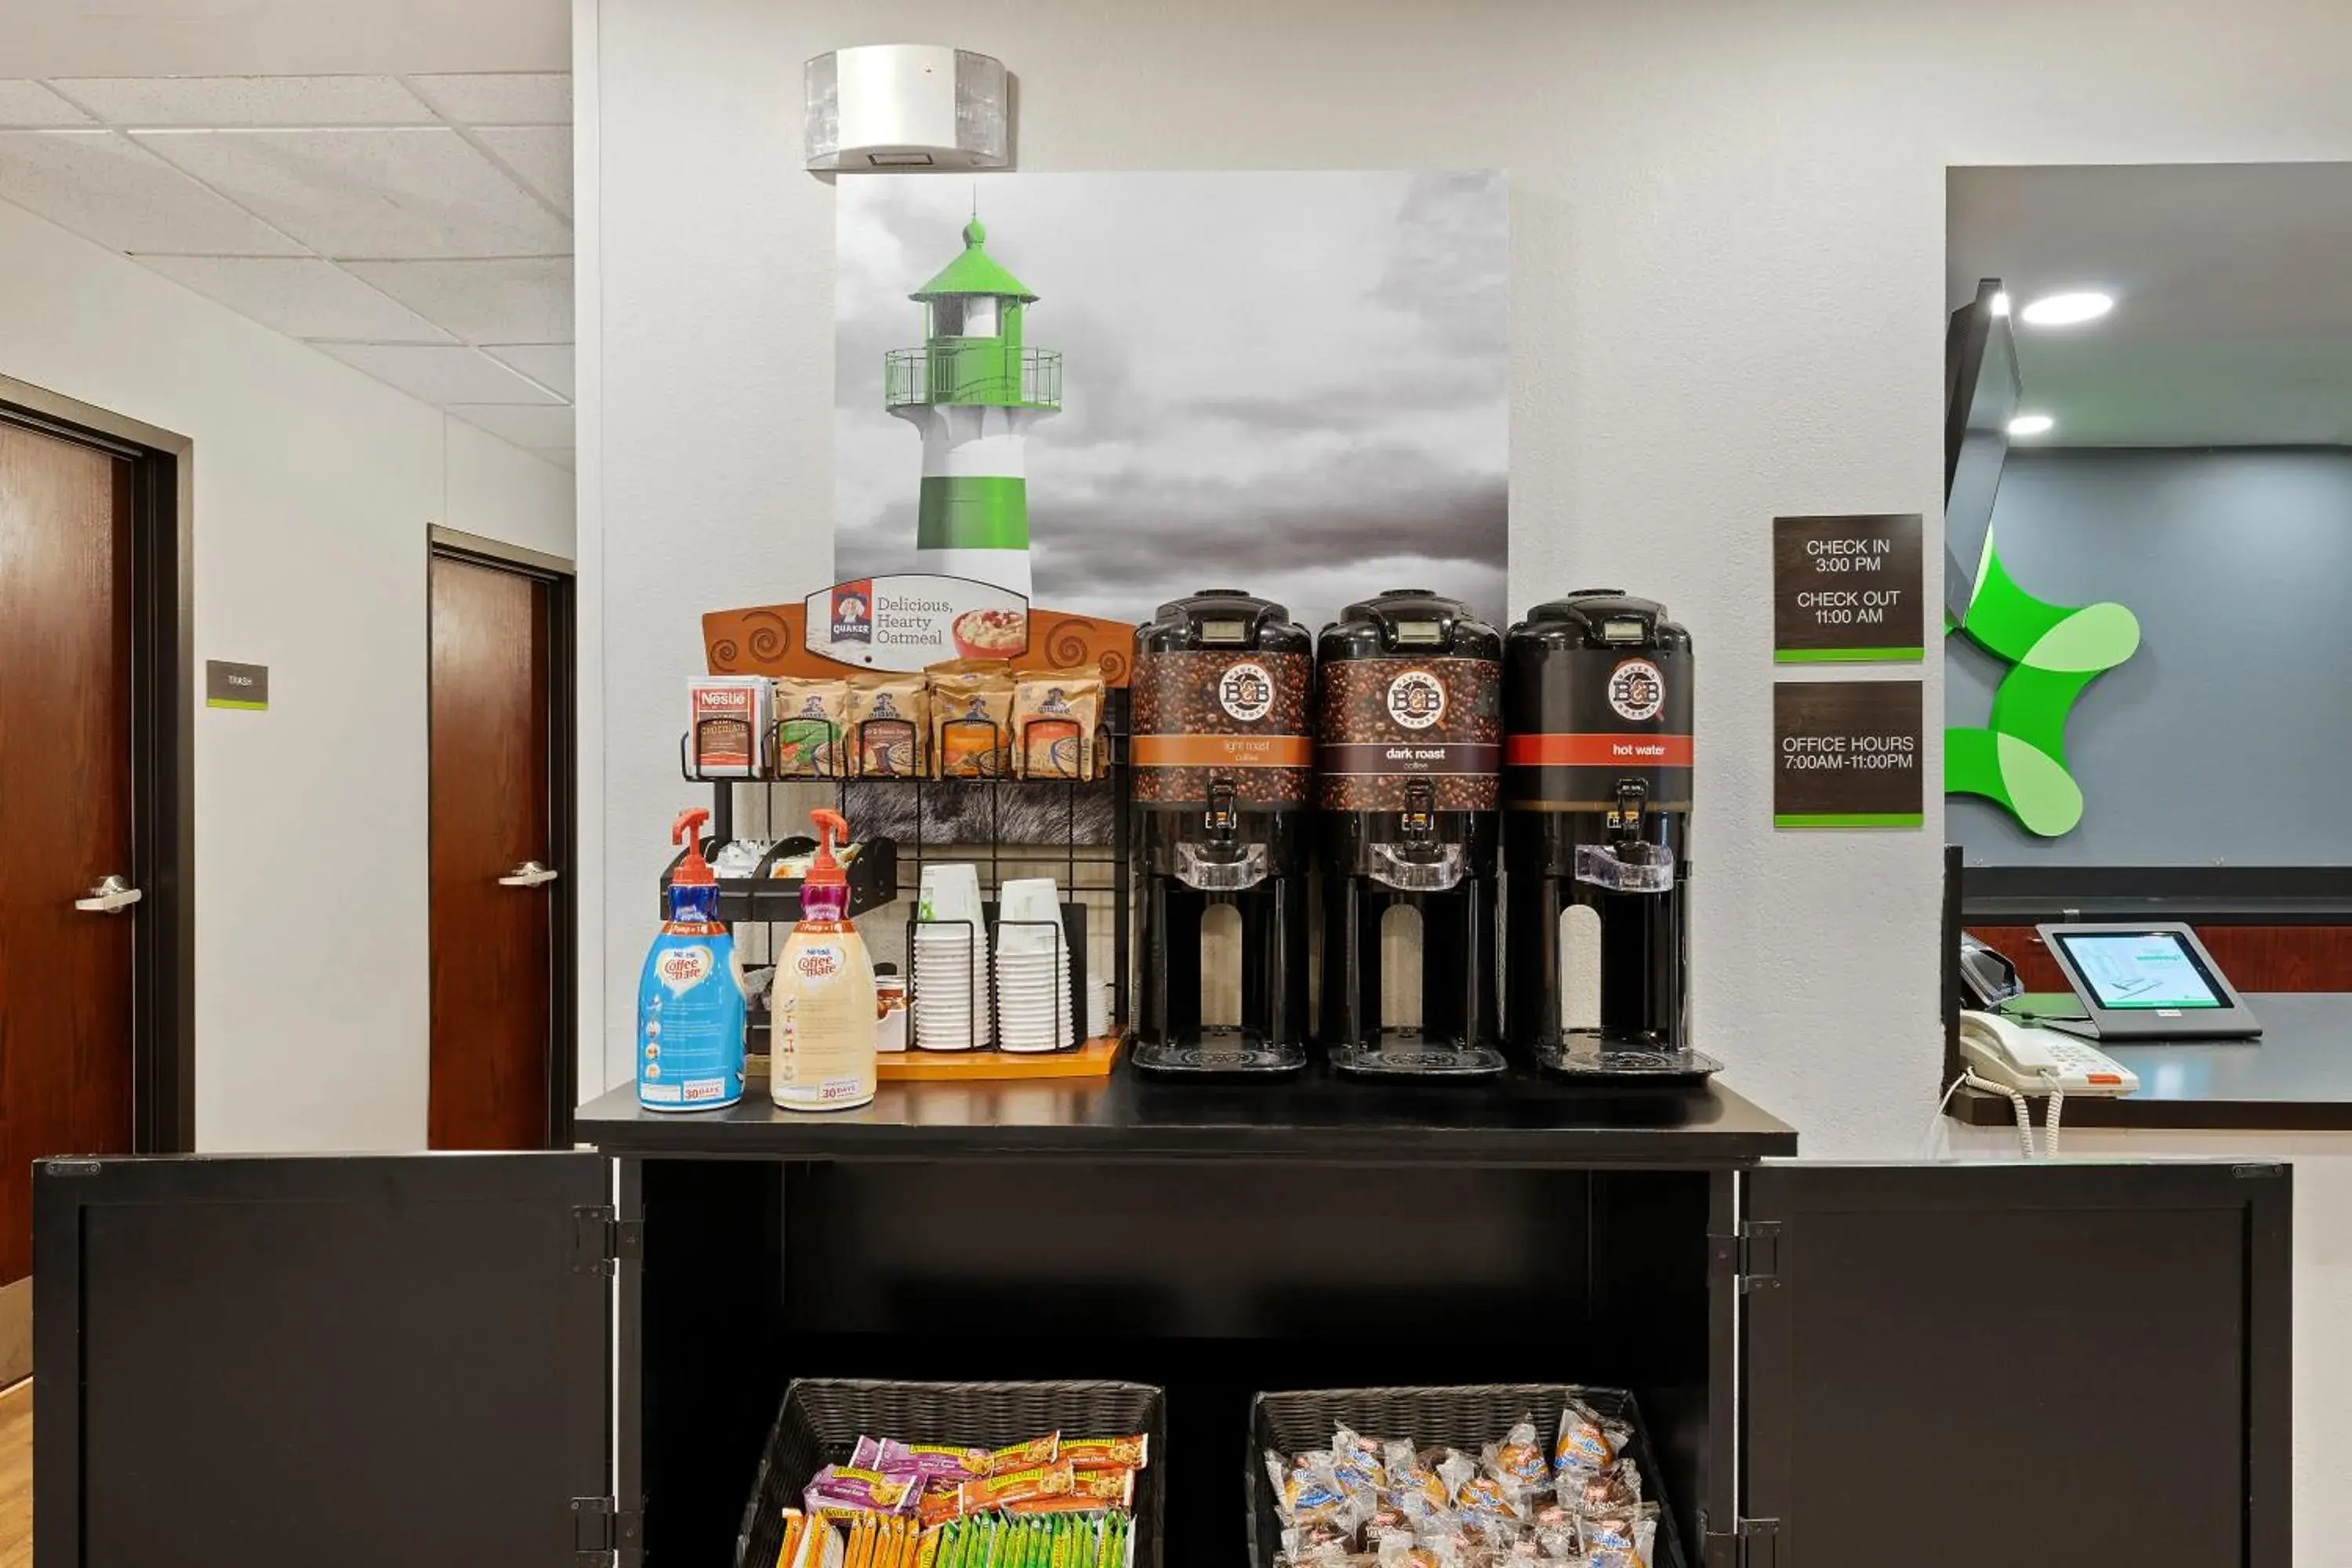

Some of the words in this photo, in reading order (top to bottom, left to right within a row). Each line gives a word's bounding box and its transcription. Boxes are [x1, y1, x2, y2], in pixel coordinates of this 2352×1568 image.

[1807, 539, 1868, 555] CHECK
[1873, 539, 1890, 554] IN
[1816, 557, 1849, 572] 3:00
[1855, 557, 1881, 571] PM
[877, 597, 953, 613] Delicious,
[1798, 592, 1859, 608] CHECK
[1863, 590, 1901, 606] OUT
[877, 614, 932, 633] Hearty
[1815, 609, 1852, 624] 11:00
[1856, 608, 1883, 623] AM
[833, 624, 869, 634] QUAKER
[877, 630, 942, 645] Oatmeal
[1613, 744, 1633, 755] hot
[1635, 744, 1666, 755] water
[1783, 737, 1846, 752] OFFICE
[1851, 736, 1915, 751] HOURS
[1386, 748, 1413, 759] dark
[1415, 748, 1446, 759] roast
[685, 1088, 699, 1099] 30
[822, 1088, 837, 1098] 30
